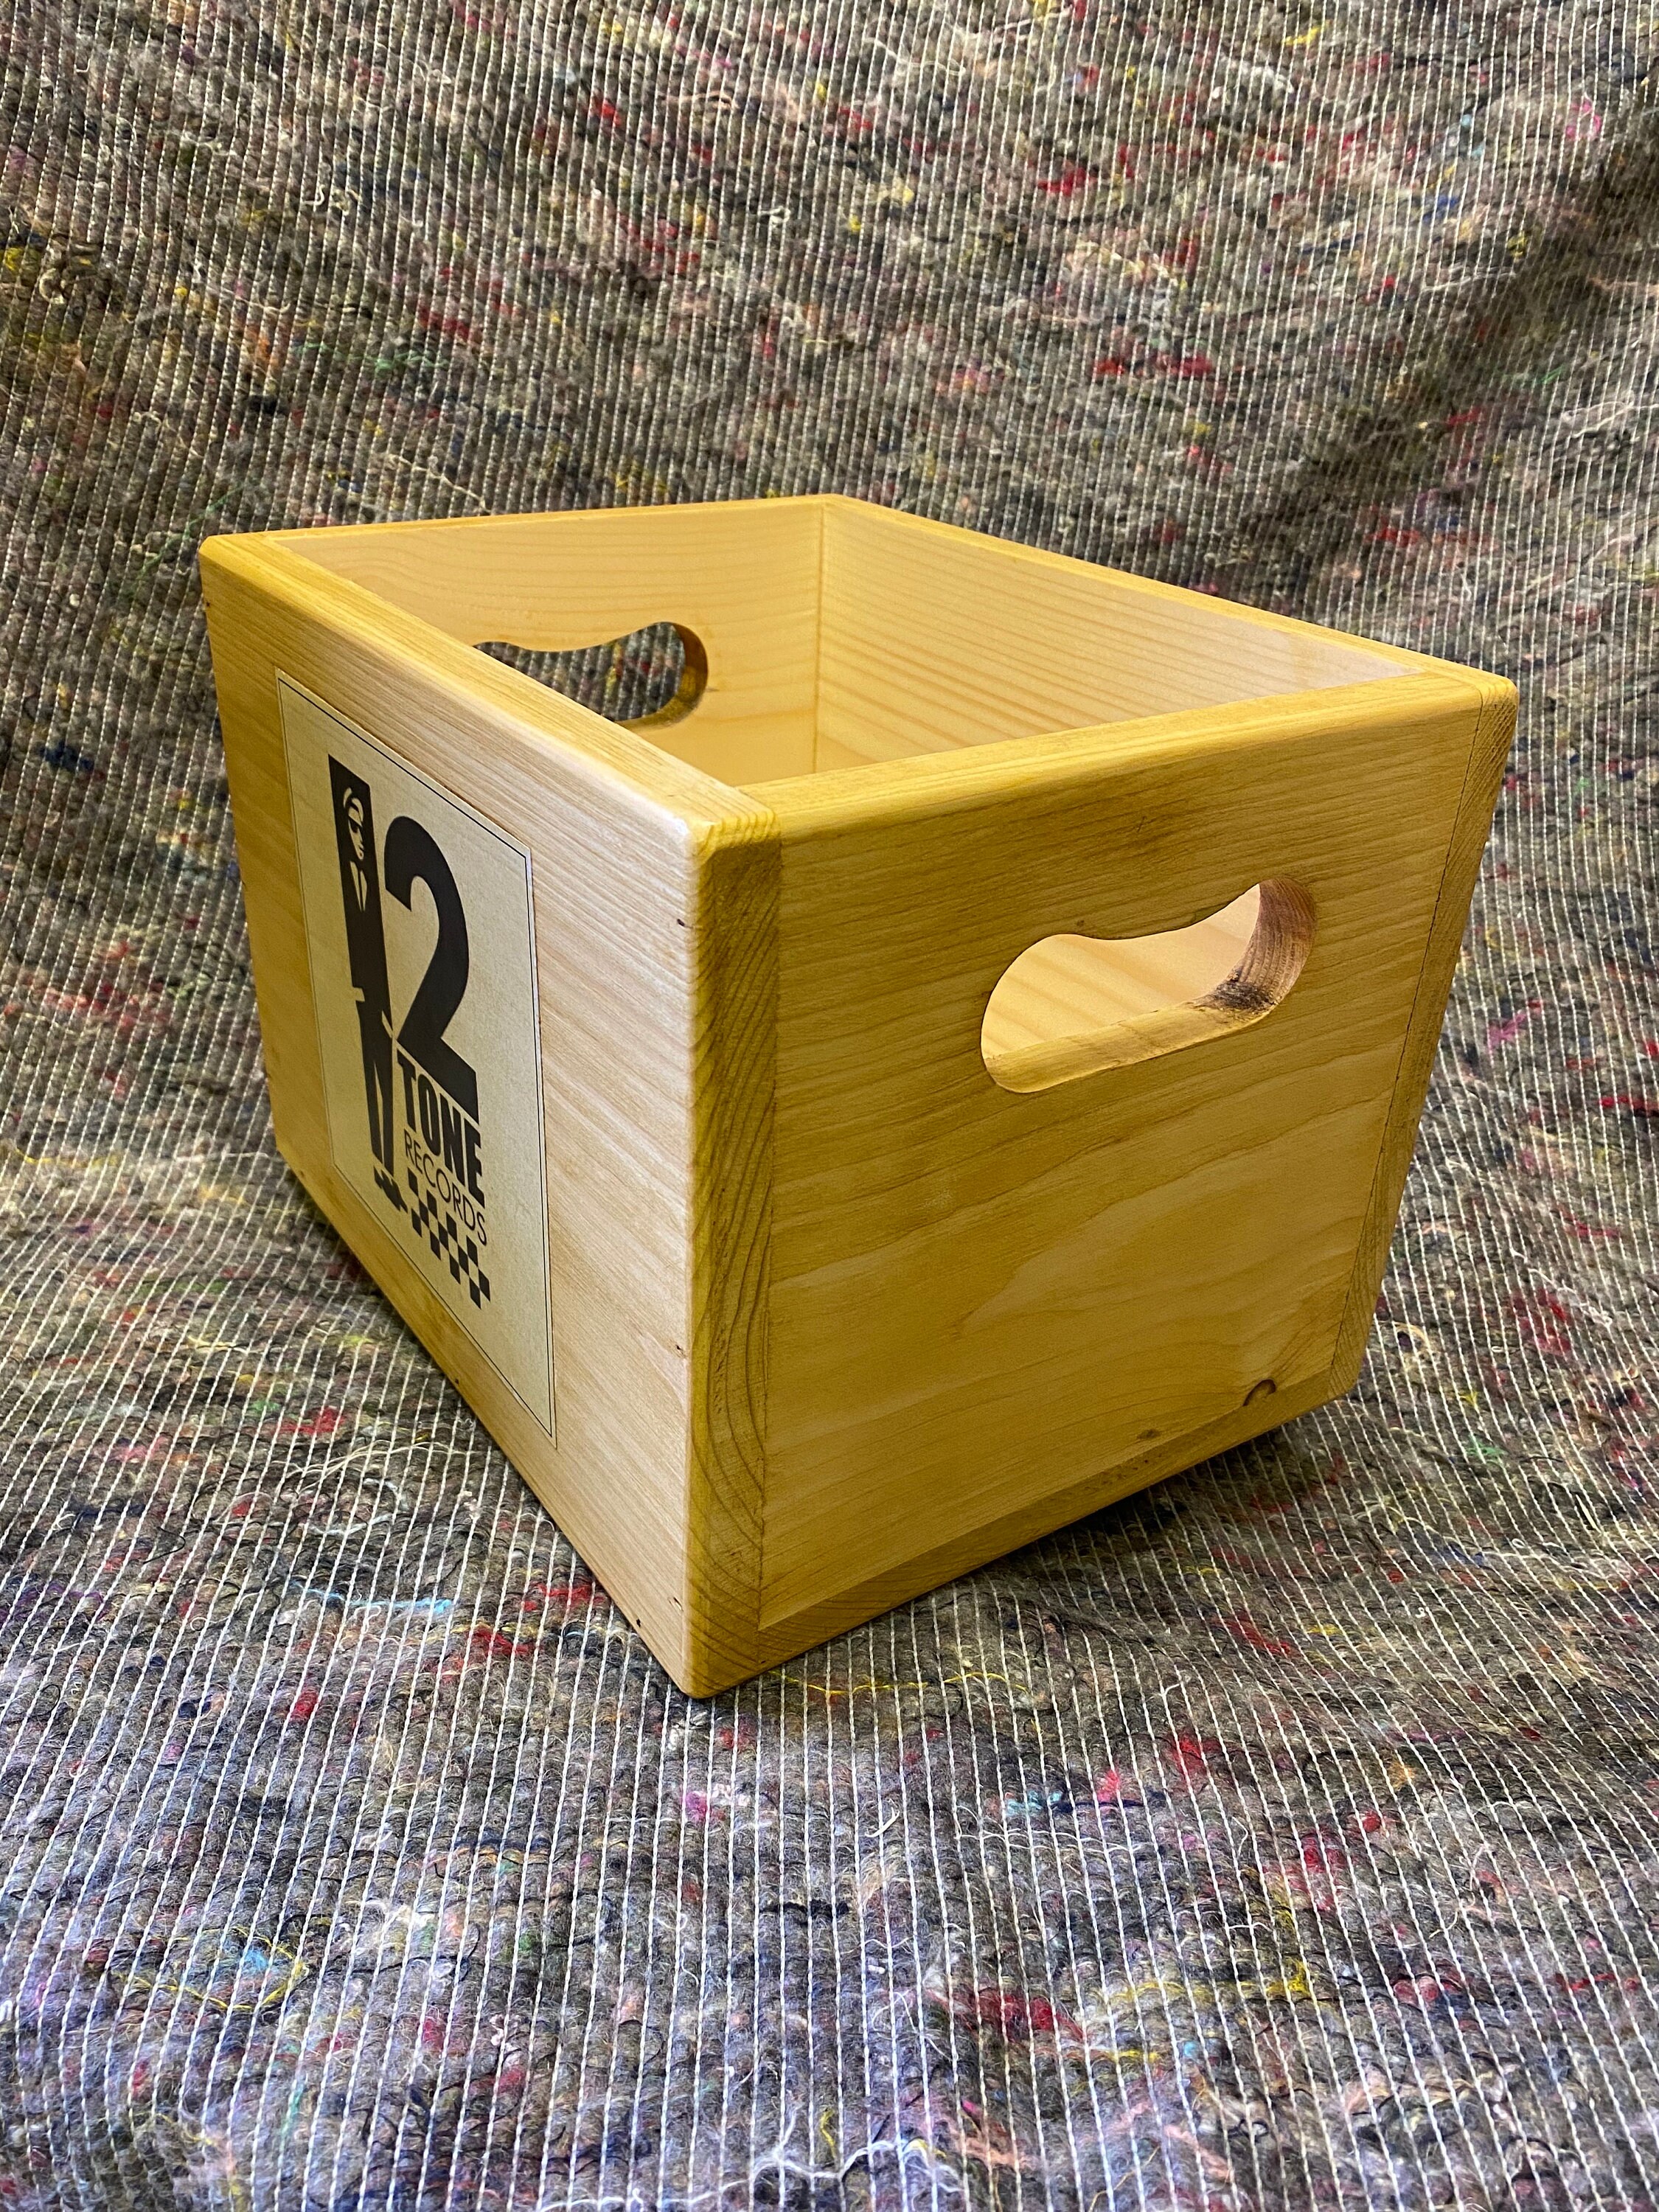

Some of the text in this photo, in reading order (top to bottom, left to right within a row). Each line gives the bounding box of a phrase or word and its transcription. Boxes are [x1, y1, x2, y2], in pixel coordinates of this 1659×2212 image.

[383, 815, 479, 1125] 2
[397, 1048, 485, 1209] TONE
[404, 1128, 487, 1246] RECORDS
